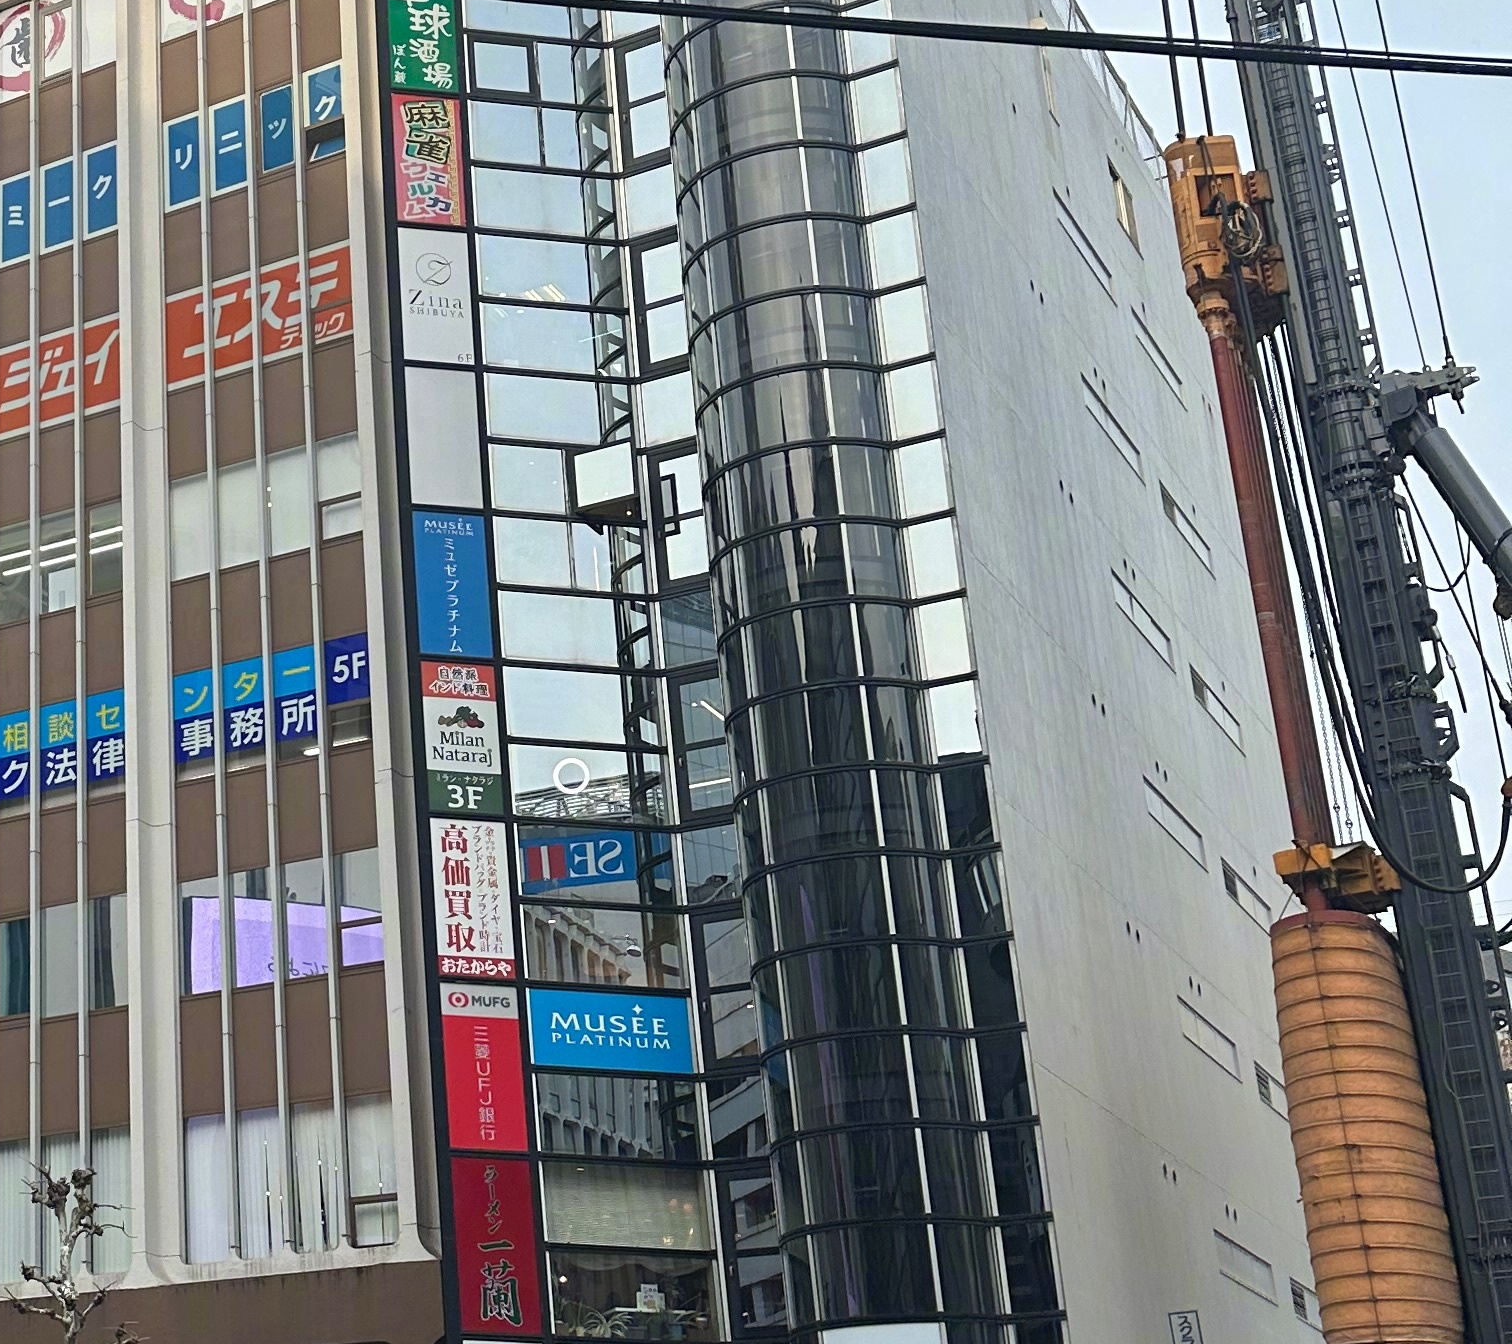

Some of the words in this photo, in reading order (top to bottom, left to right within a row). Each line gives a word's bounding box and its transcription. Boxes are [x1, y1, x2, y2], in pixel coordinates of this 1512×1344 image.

[403, 100, 452, 165] 麻雀
[408, 288, 465, 310] Zina
[408, 306, 465, 319] SHIBUYA
[442, 537, 464, 654] ミュゼプラチナム
[331, 649, 367, 684] 5F
[439, 731, 486, 749] Milan
[432, 746, 493, 768] Nataraj
[447, 785, 485, 810] 3F
[439, 823, 477, 954] 高価買取
[441, 957, 513, 977] おたからや
[471, 996, 511, 1008] MUFG
[551, 1031, 671, 1050] PLATINUM
[473, 1024, 498, 1142] 三菱UFJ銀行
[477, 1238, 524, 1328] 一蘭
